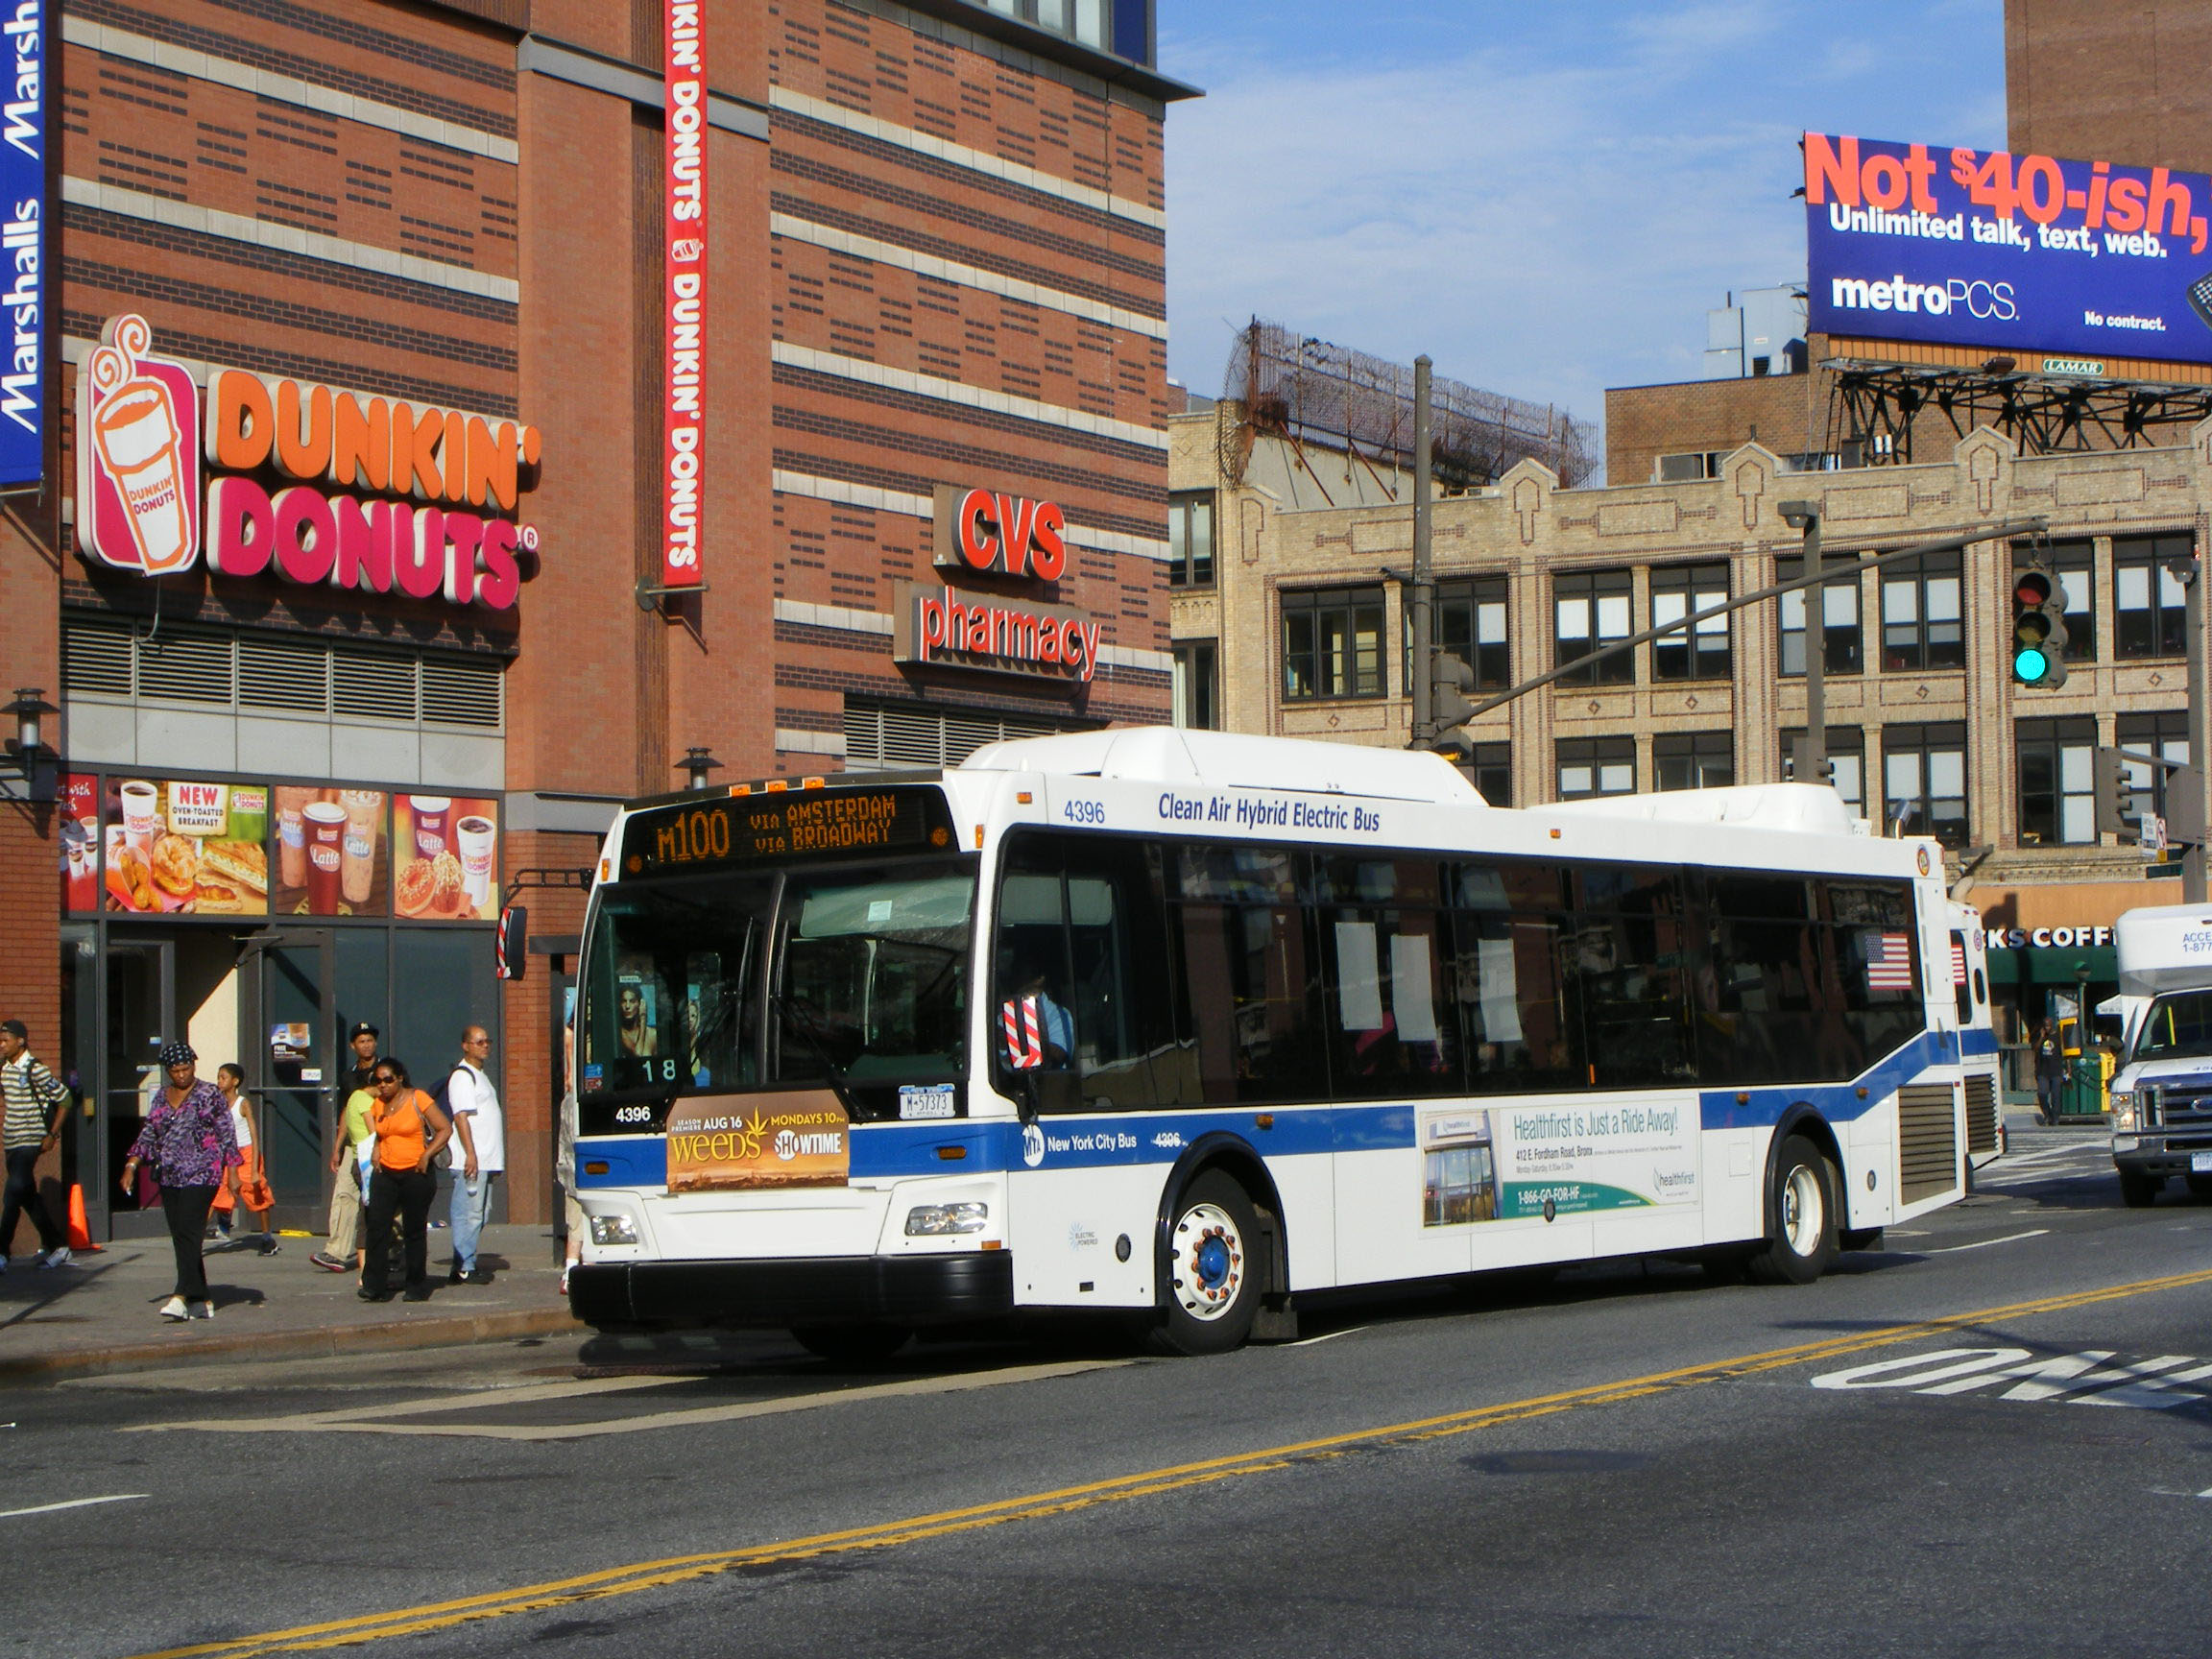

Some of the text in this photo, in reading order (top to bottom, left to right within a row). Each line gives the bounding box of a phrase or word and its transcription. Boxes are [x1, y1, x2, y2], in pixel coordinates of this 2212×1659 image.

[672, 0, 701, 221] KIN' DONUTS
[1805, 132, 2207, 254] Not $40-ish,
[1829, 203, 2168, 258] Unlimited talk, text, web.
[1, 198, 38, 435] Marshalls
[2084, 310, 2166, 331] No contract.
[2048, 360, 2099, 373] LAMAR
[668, 273, 701, 567] DUNKIN' DONUTS
[213, 370, 541, 511] DUNKIN'
[129, 474, 174, 502] DUNKIN'
[132, 489, 176, 516] DONUTS
[208, 476, 519, 609] DONUTS
[959, 488, 1067, 582] CVS
[918, 584, 1102, 683] pharmacy
[179, 785, 219, 806] NEW
[172, 806, 224, 817] OVEN-TOASTED
[178, 818, 219, 828] BREAKFAST
[1064, 793, 1381, 831] 4396 Clean Air Hybrid Electric Bus
[657, 795, 896, 862] M100 VIA AMSTERDAM
[755, 819, 892, 853] VIA BROADWAY
[312, 849, 340, 864] Latte
[1982, 926, 2117, 949] KS COFF
[615, 1106, 651, 1122] 4396
[703, 1116, 743, 1131] AUG 16
[771, 1114, 823, 1126] MONDAYS
[1514, 1106, 1678, 1140] Healthfirst is Just a Ride Away!
[775, 1129, 842, 1161] SHOWTIME
[1047, 1137, 1070, 1151] New
[1071, 1134, 1094, 1150] York
[1095, 1134, 1117, 1152] City
[1118, 1133, 1137, 1147] Bus
[1659, 1172, 1695, 1186] healthfirst
